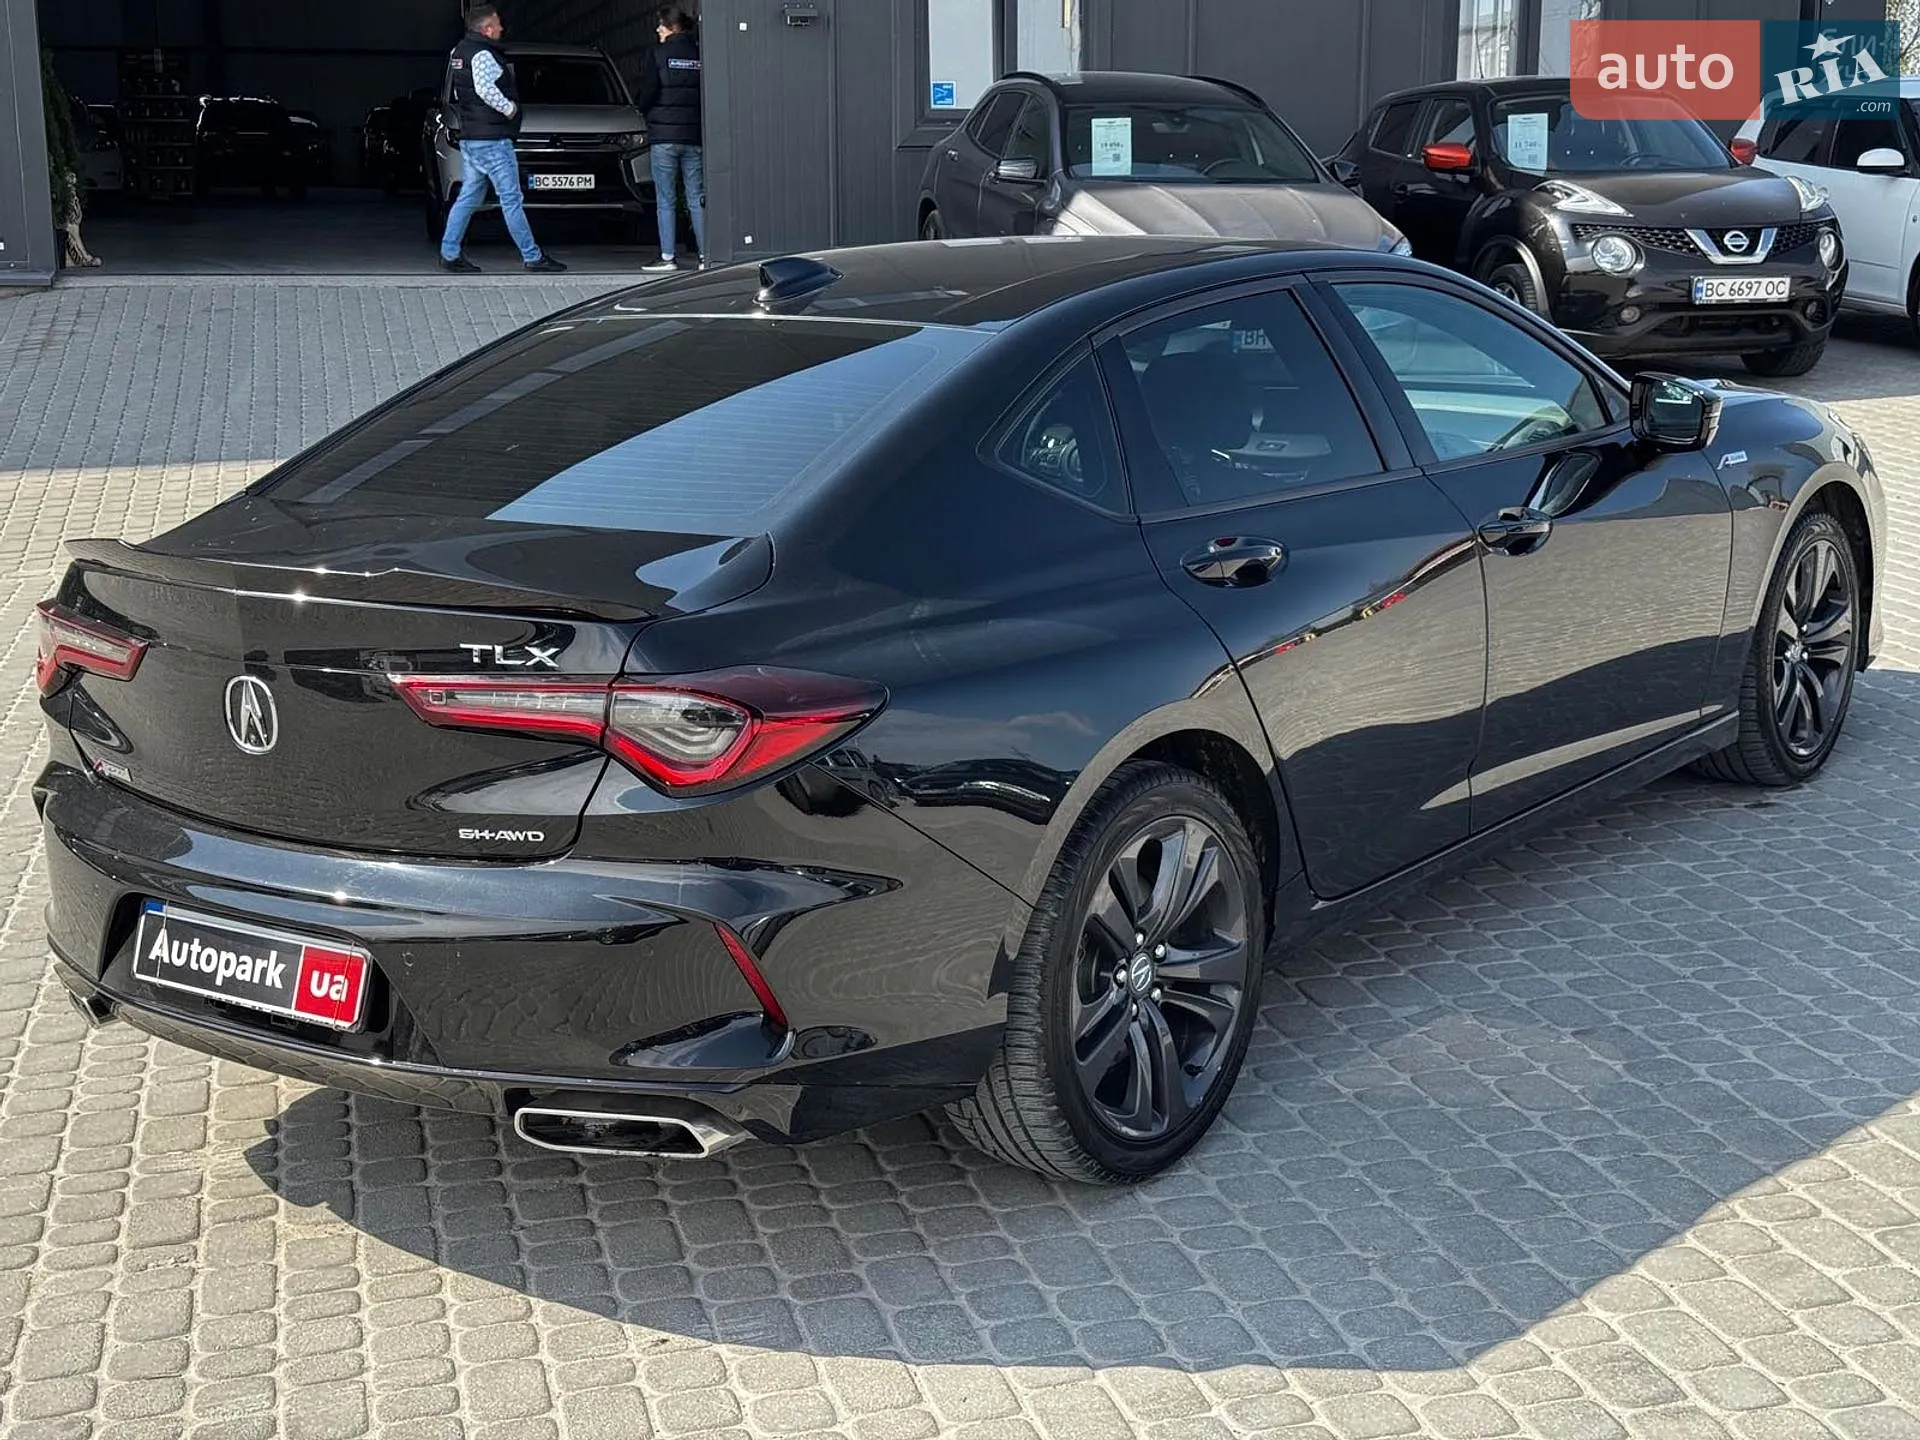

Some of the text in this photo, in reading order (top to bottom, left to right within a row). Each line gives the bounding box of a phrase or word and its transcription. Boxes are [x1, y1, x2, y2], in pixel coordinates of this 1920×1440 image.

[535, 176, 593, 188] BC 5576 PM
[1705, 280, 1786, 297] BC 6697 OC
[460, 643, 560, 668] TLX
[458, 828, 545, 842] SH-AWD
[148, 928, 349, 1002] Autopark ua
